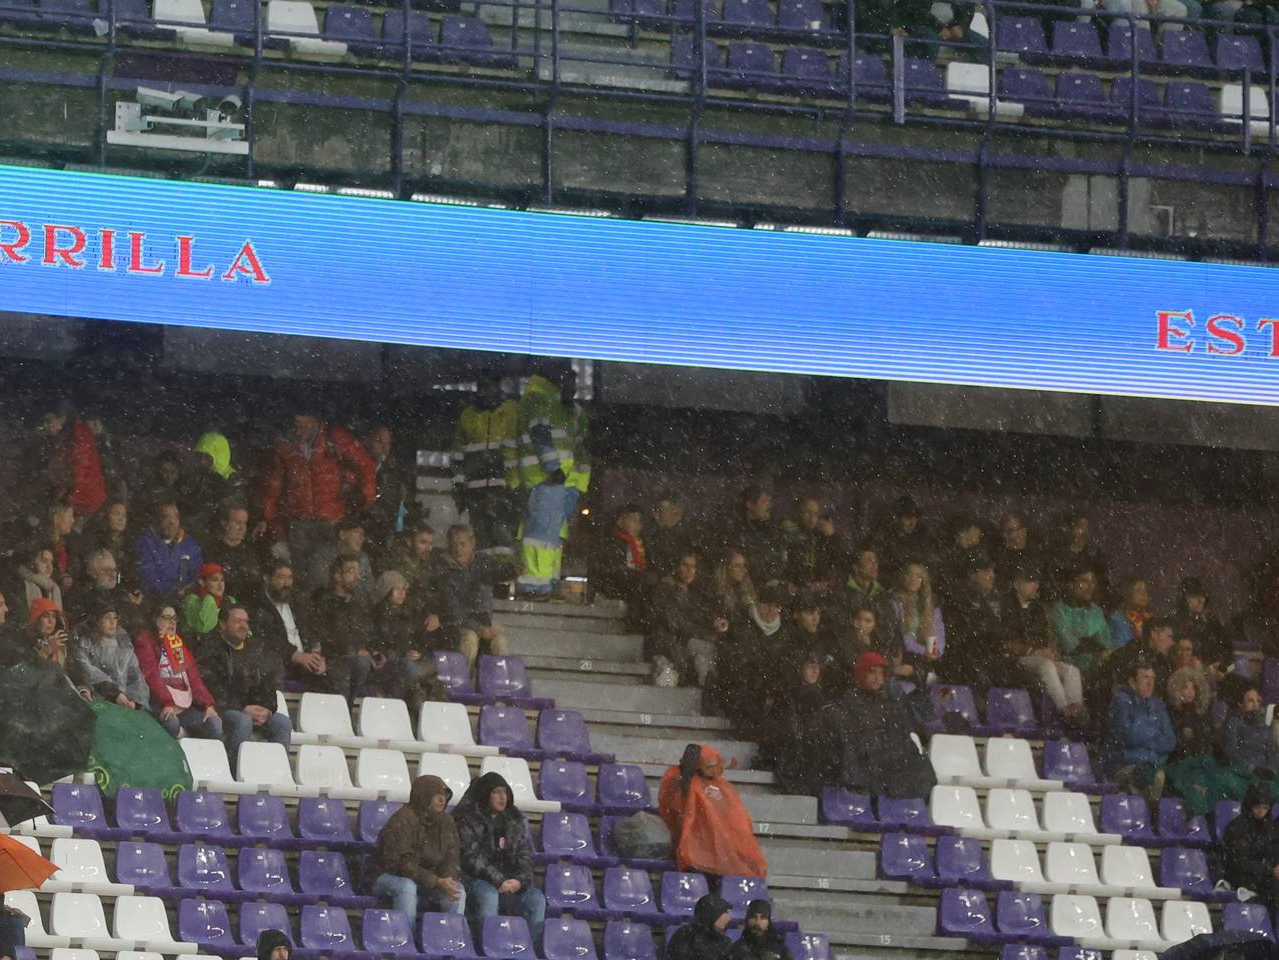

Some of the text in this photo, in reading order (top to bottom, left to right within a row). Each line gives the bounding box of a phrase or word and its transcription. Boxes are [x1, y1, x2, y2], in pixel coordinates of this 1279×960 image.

[579, 660, 592, 671] 20
[640, 714, 652, 725] 19
[758, 823, 770, 833] 17
[816, 879, 829, 889] 16
[879, 935, 892, 945] 15
